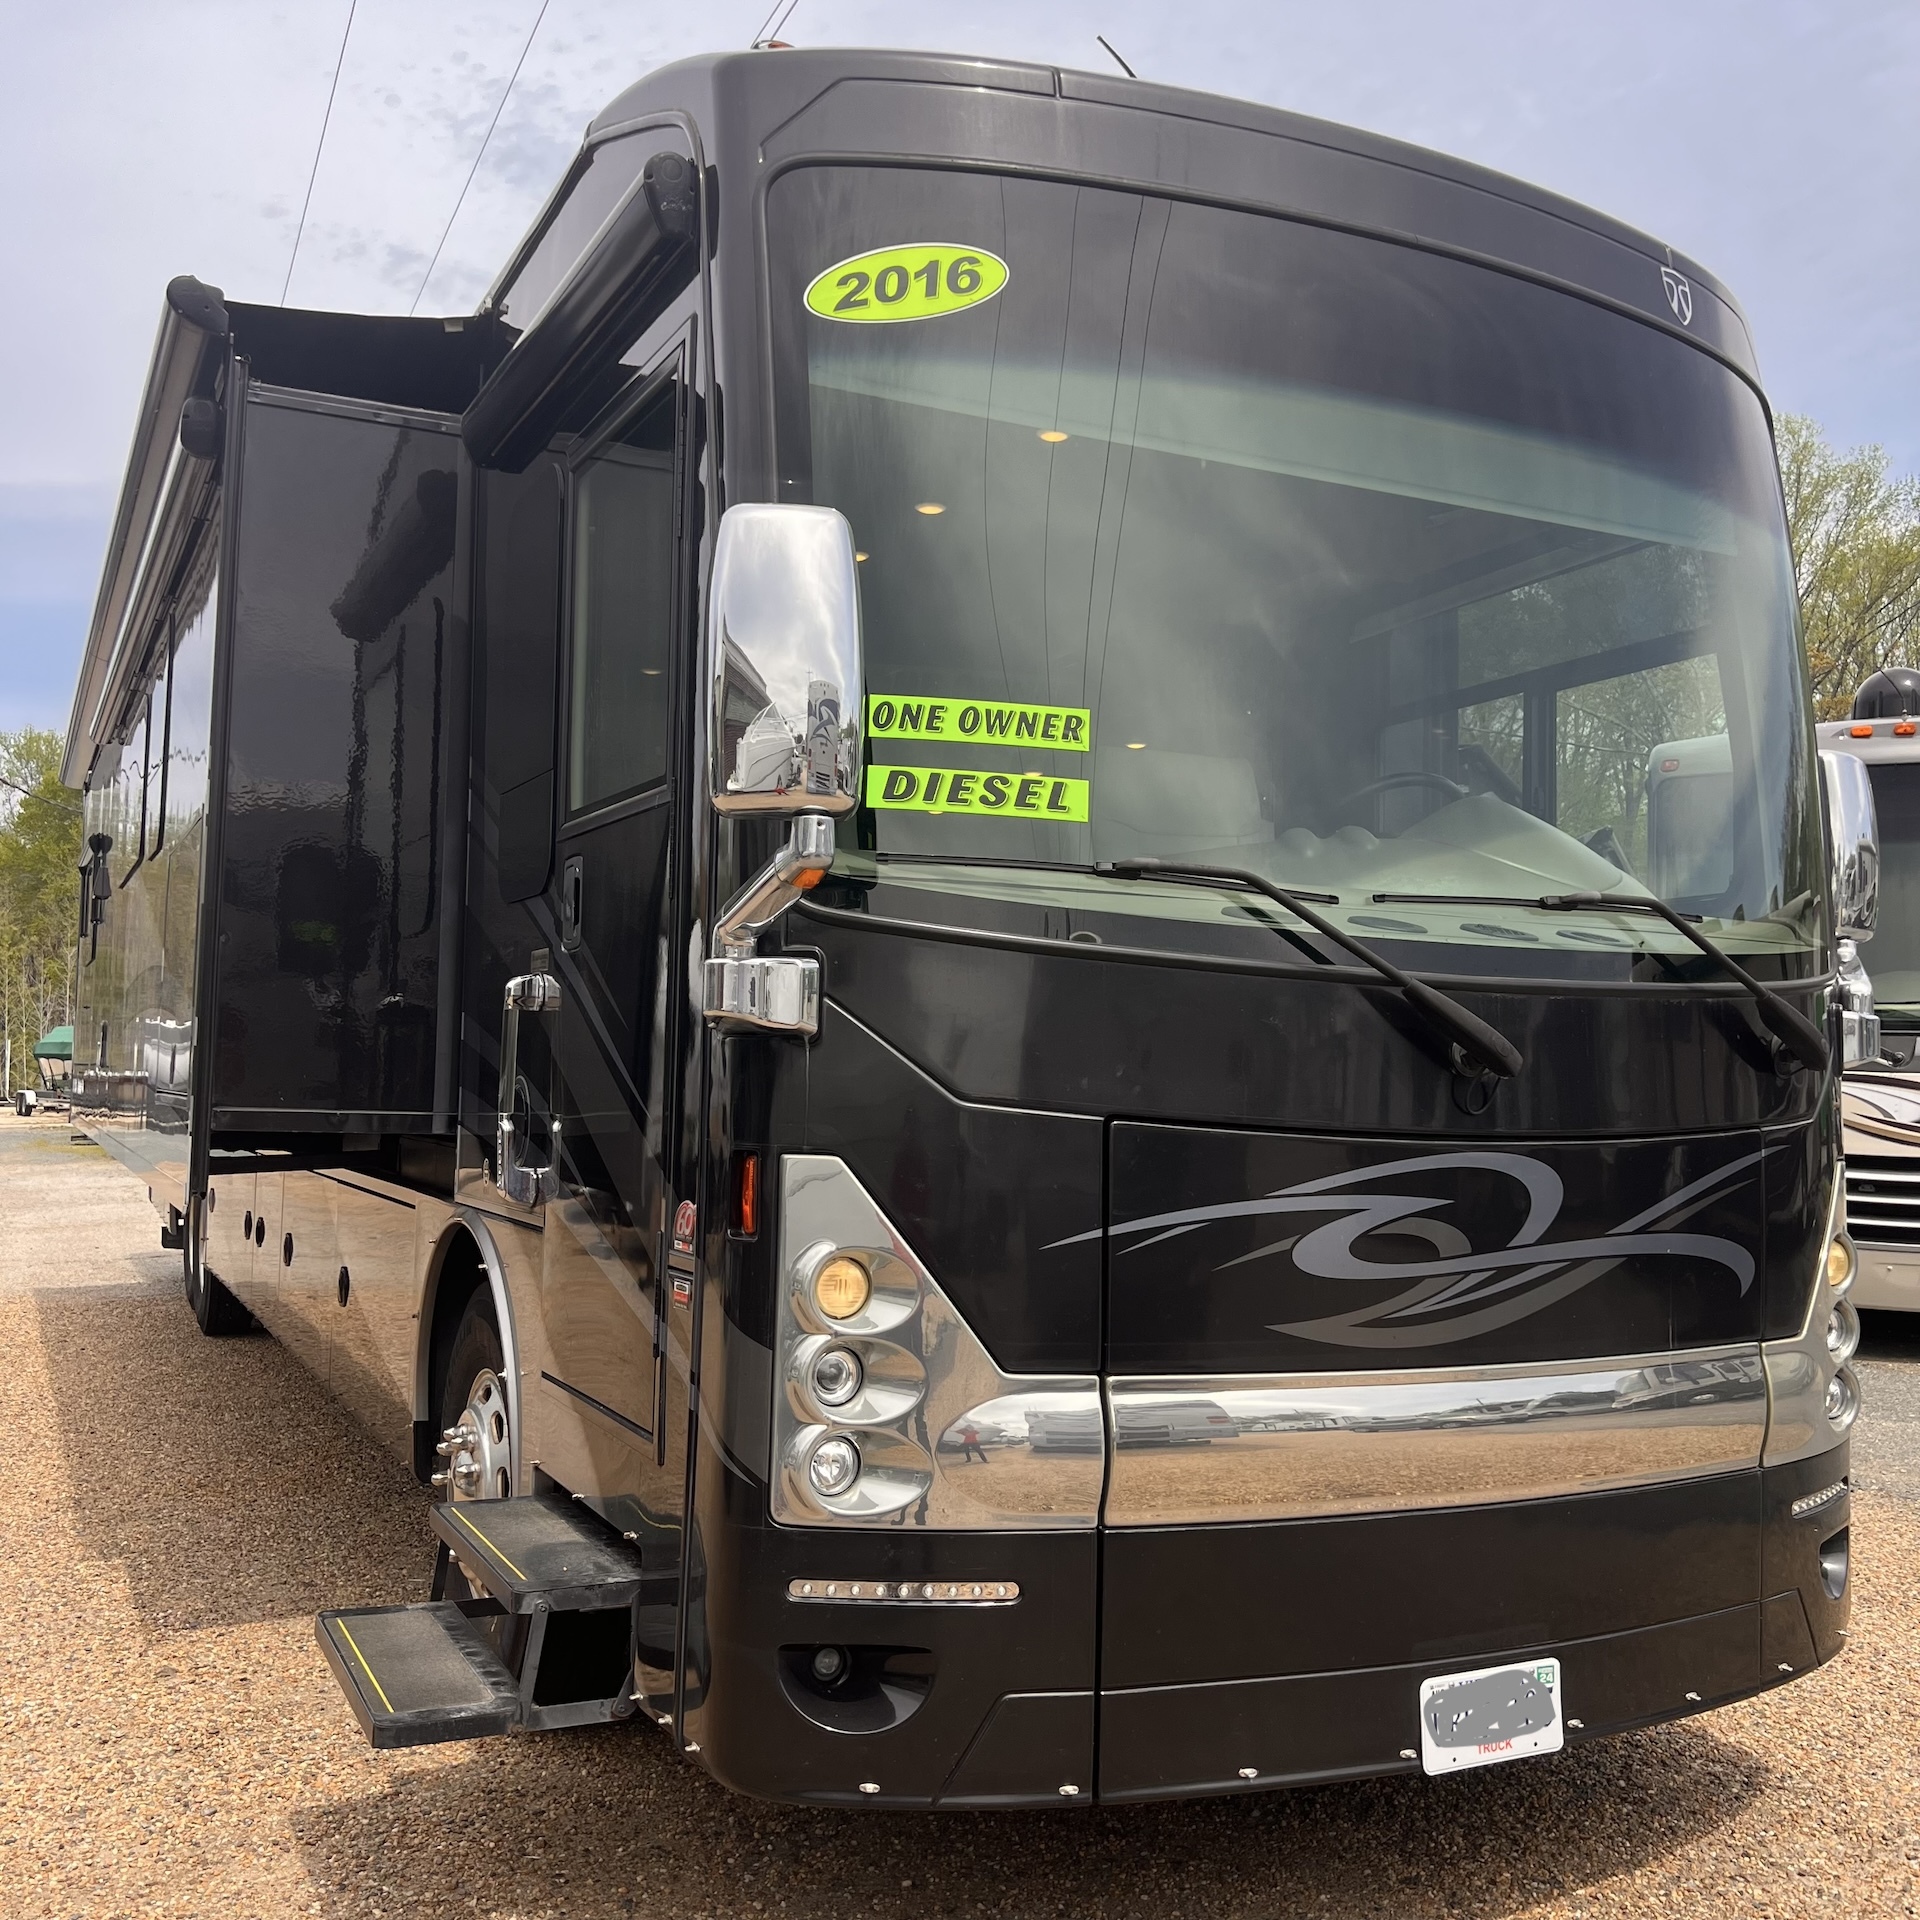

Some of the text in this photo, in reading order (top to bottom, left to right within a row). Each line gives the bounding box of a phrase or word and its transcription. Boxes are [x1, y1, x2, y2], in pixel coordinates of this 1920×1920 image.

[833, 256, 983, 314] 2016
[872, 701, 1084, 742] ONE OWNER
[882, 770, 1069, 812] DIESEL
[1540, 1672, 1553, 1683] 24
[1477, 1739, 1512, 1754] TRUCK
